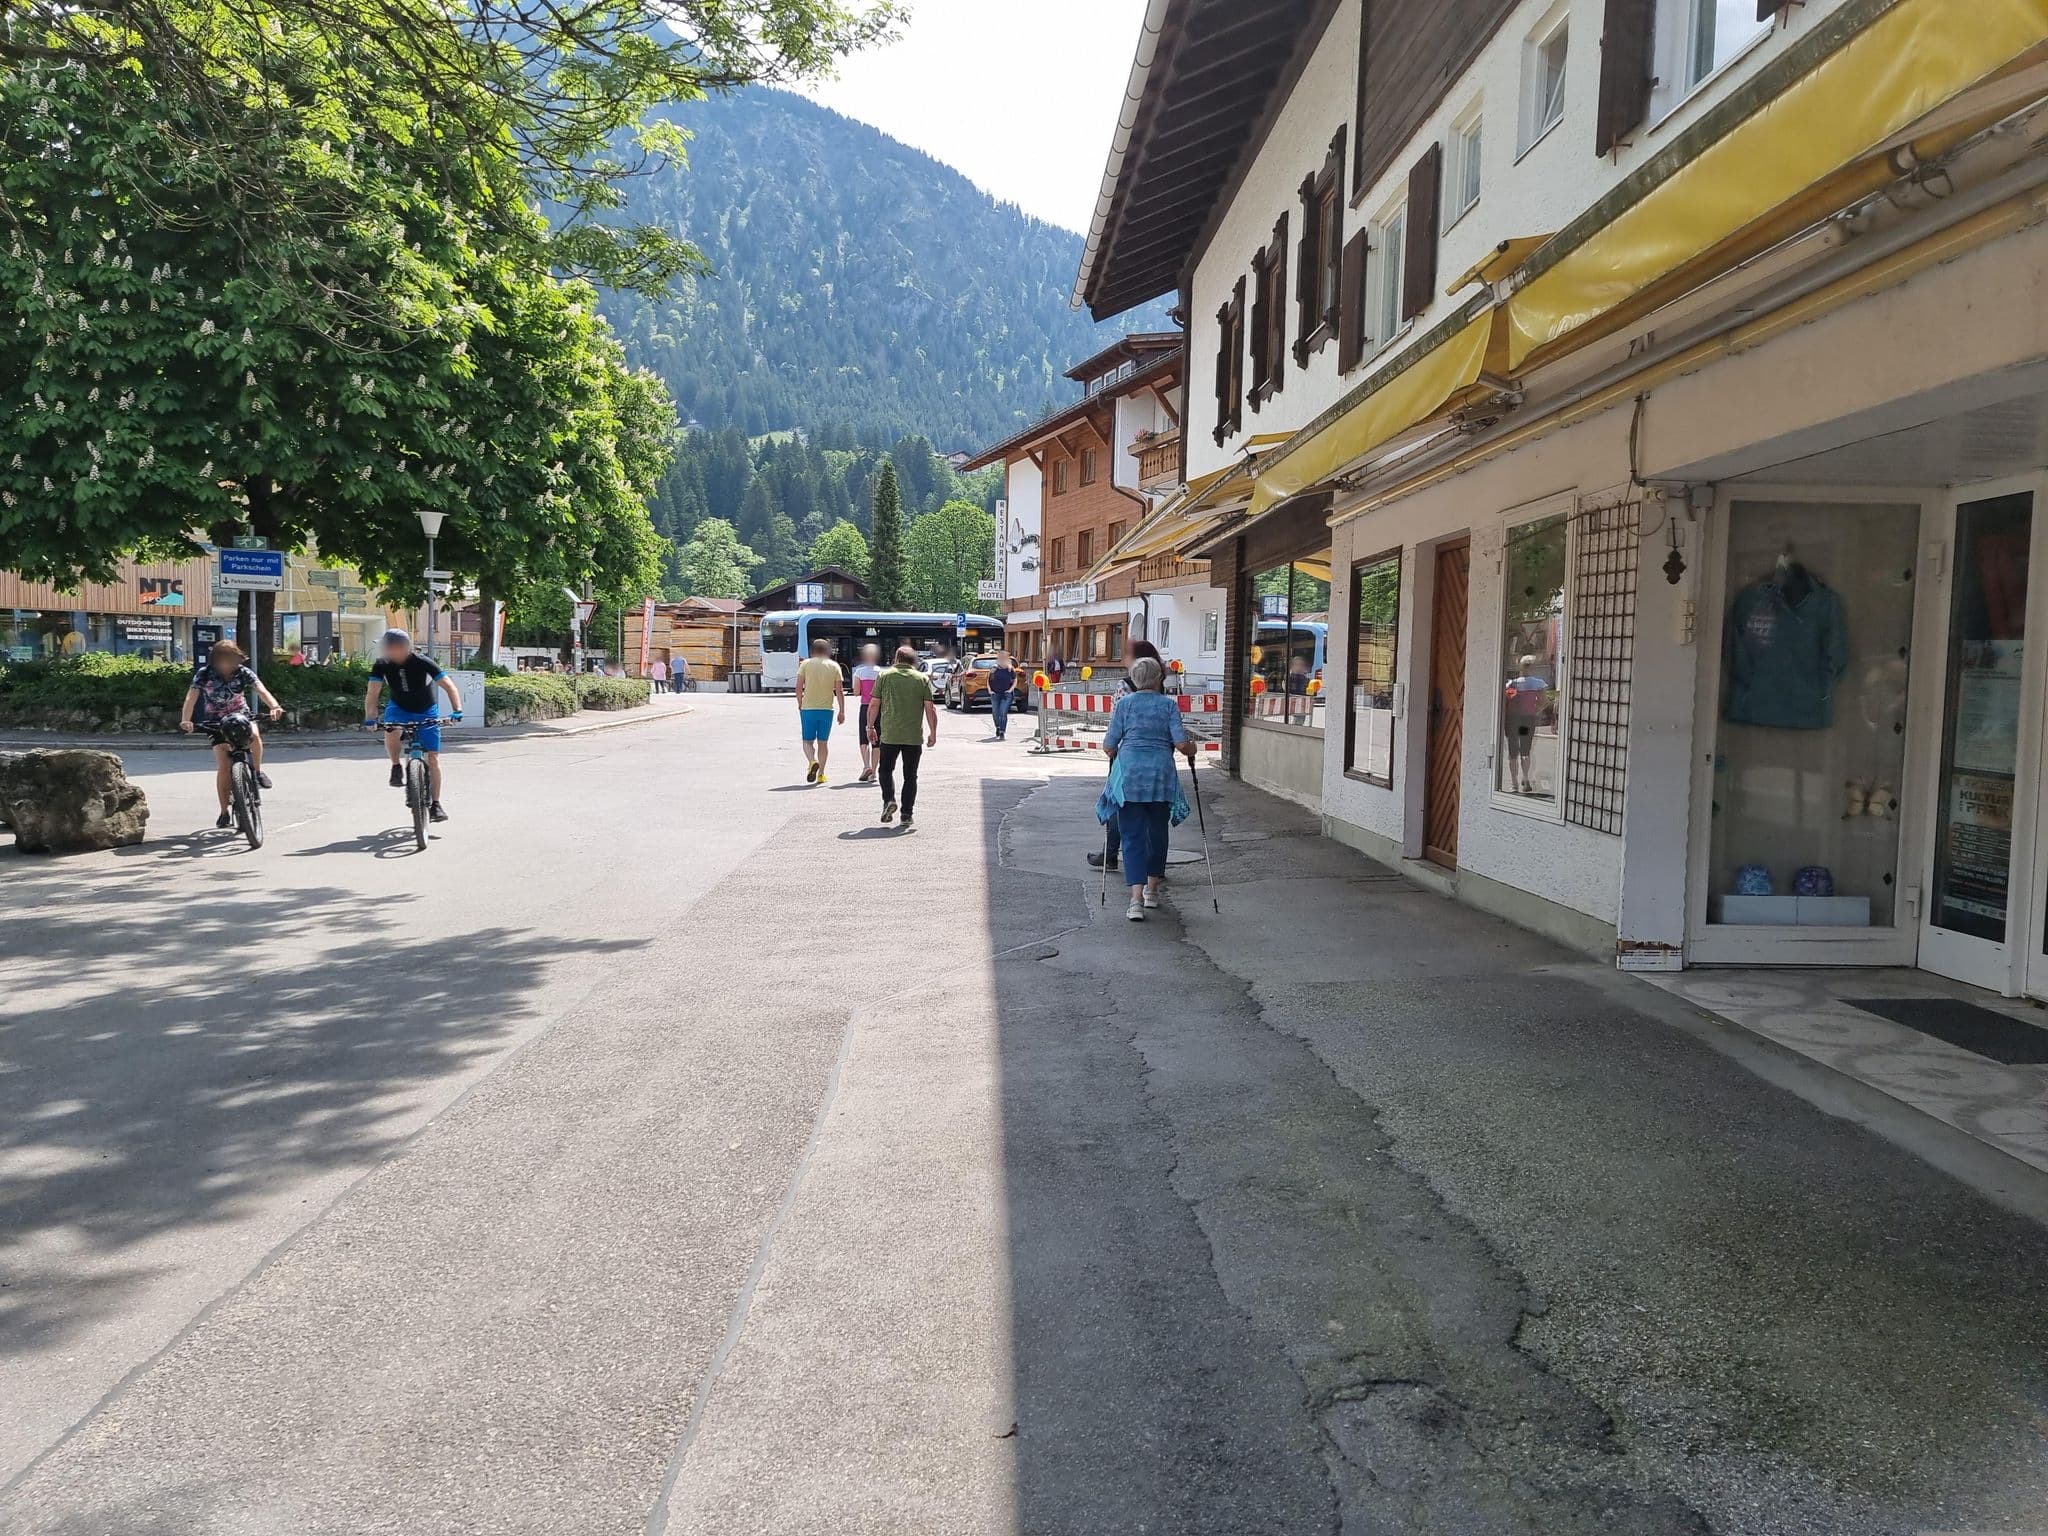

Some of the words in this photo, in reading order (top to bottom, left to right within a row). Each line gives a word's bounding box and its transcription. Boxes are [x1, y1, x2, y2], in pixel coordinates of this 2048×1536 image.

[223, 554, 250, 562] Parken
[231, 563, 272, 572] Parkschein
[140, 577, 183, 596] NTC
[981, 591, 1003, 599] HOTEL
[957, 615, 964, 626] P
[1959, 789, 2010, 807] KULTUR
